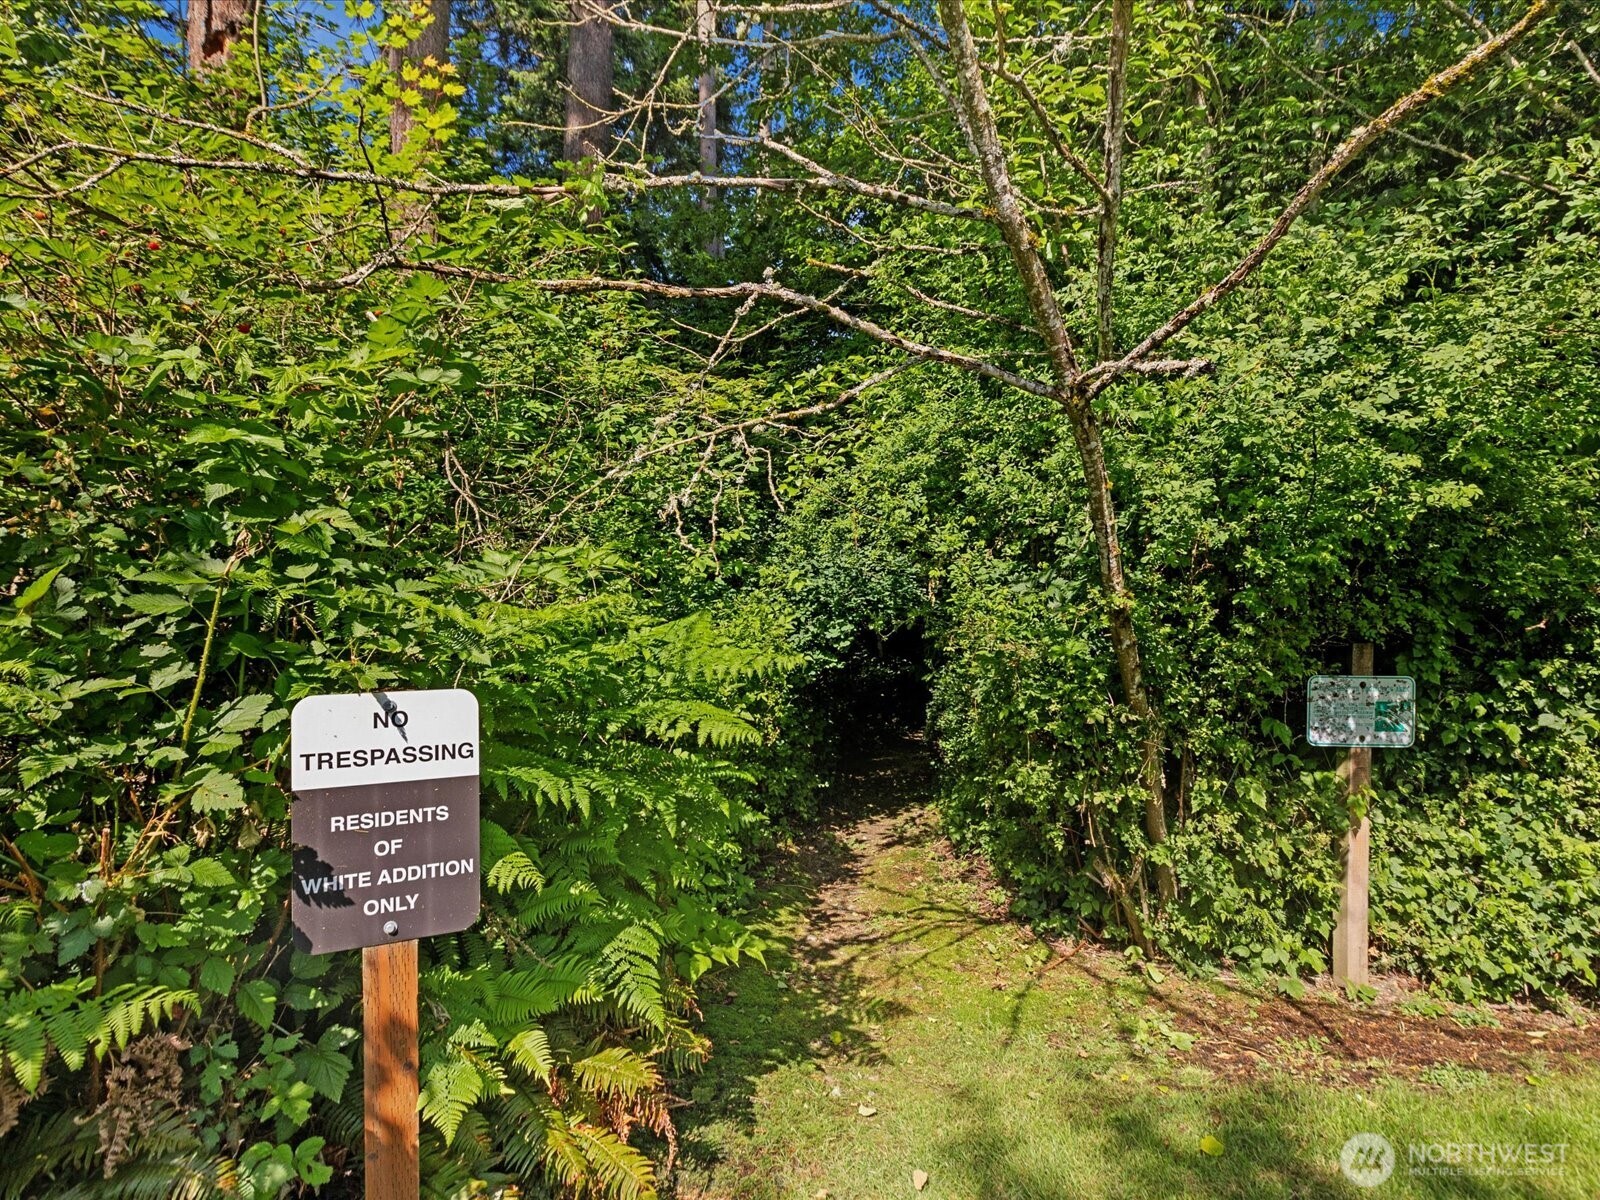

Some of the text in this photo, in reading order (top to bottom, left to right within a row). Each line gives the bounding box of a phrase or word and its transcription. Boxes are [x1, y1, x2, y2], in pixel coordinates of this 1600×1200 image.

[373, 710, 409, 729] NO
[299, 742, 474, 771] TRESPASSING
[330, 805, 449, 832] RESIDENTS
[373, 839, 402, 856] OF
[301, 858, 474, 895] WHITE ADDITION
[363, 894, 419, 916] ONLY
